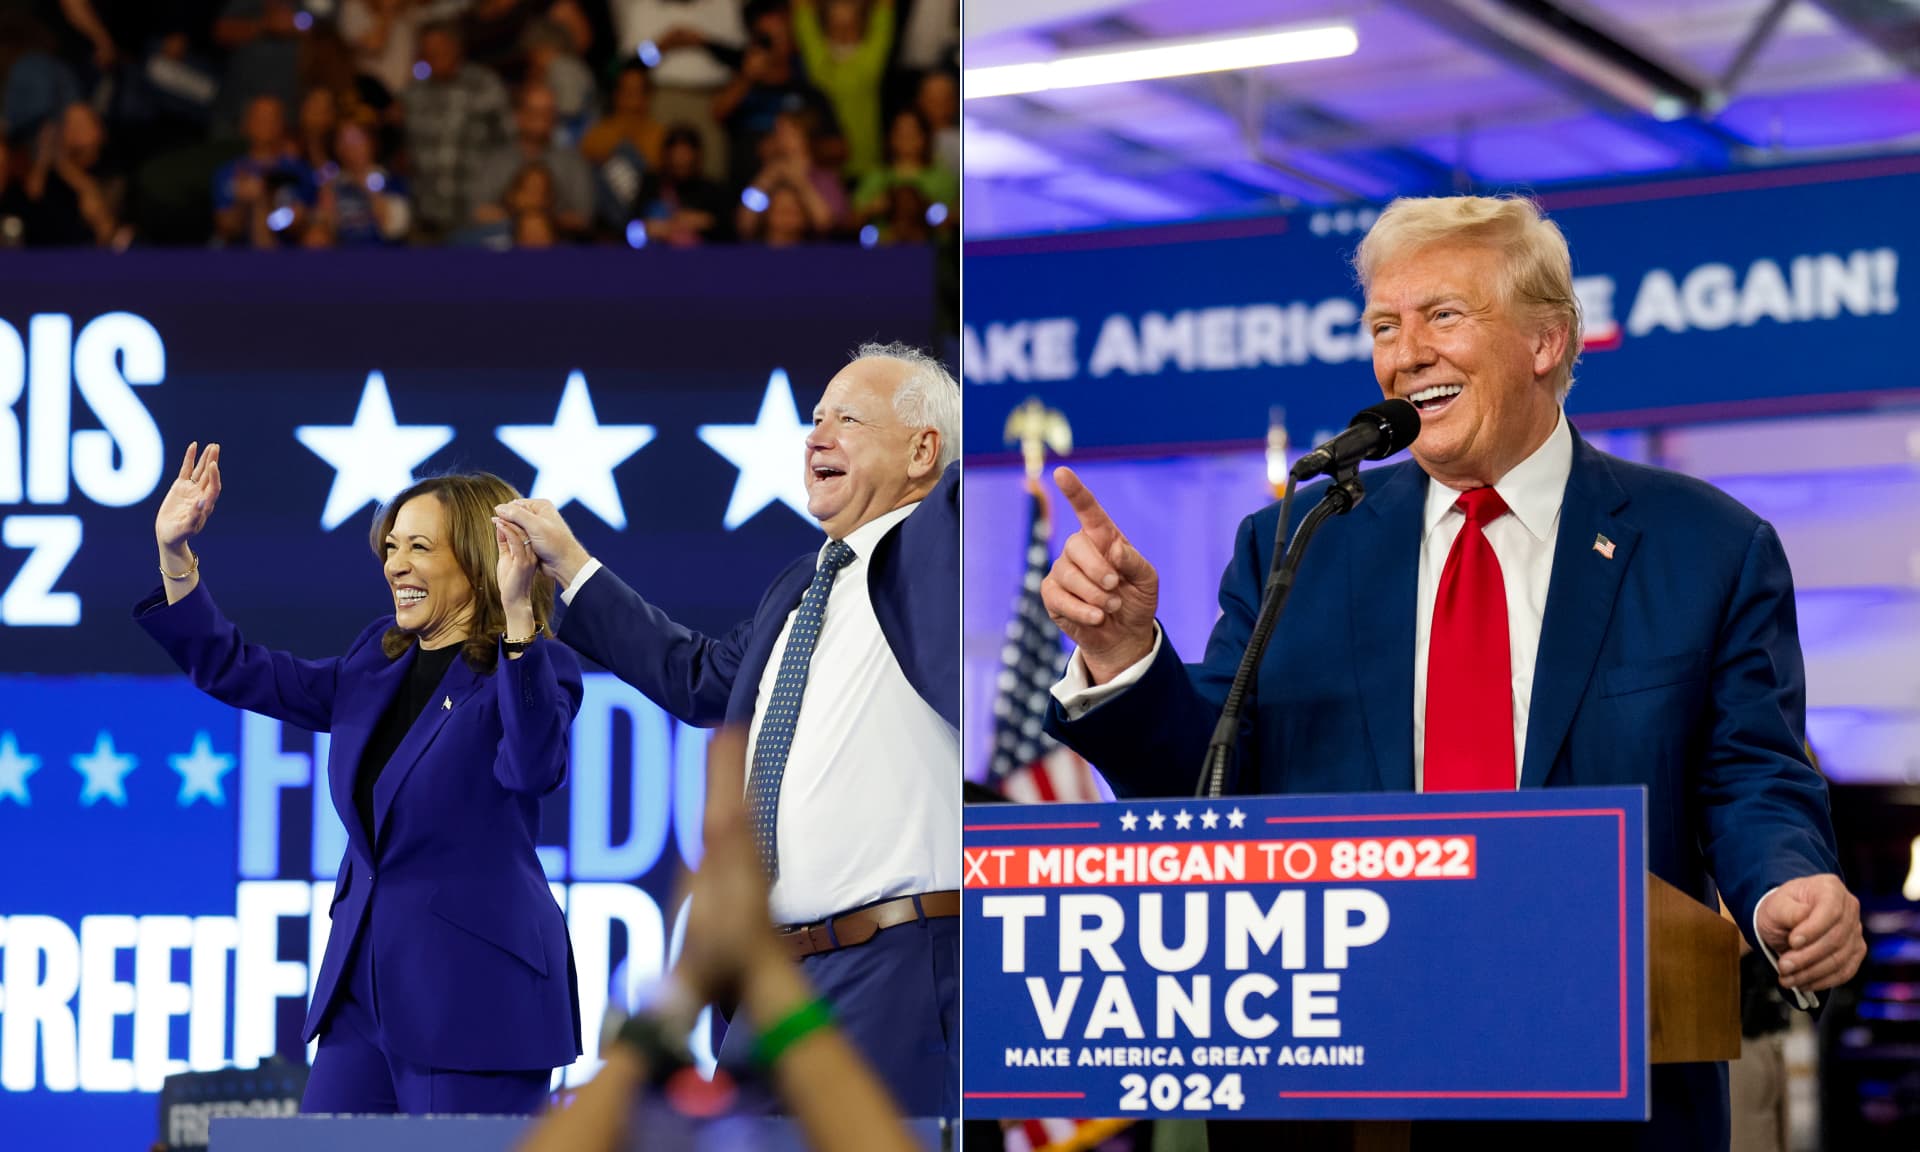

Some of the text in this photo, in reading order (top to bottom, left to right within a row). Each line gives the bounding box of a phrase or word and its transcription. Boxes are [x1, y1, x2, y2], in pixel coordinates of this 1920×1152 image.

[1627, 248, 1899, 336] AGAIN!
[0, 311, 166, 507] IS
[964, 838, 1470, 886] XT MICHIGAN TO 88022
[982, 888, 1390, 973] TRUMP
[1025, 973, 1341, 1040] VANCE
[1005, 1045, 1364, 1067] MAKE AMERICA GREAT AGAIN!
[1119, 1072, 1246, 1112] 2024
